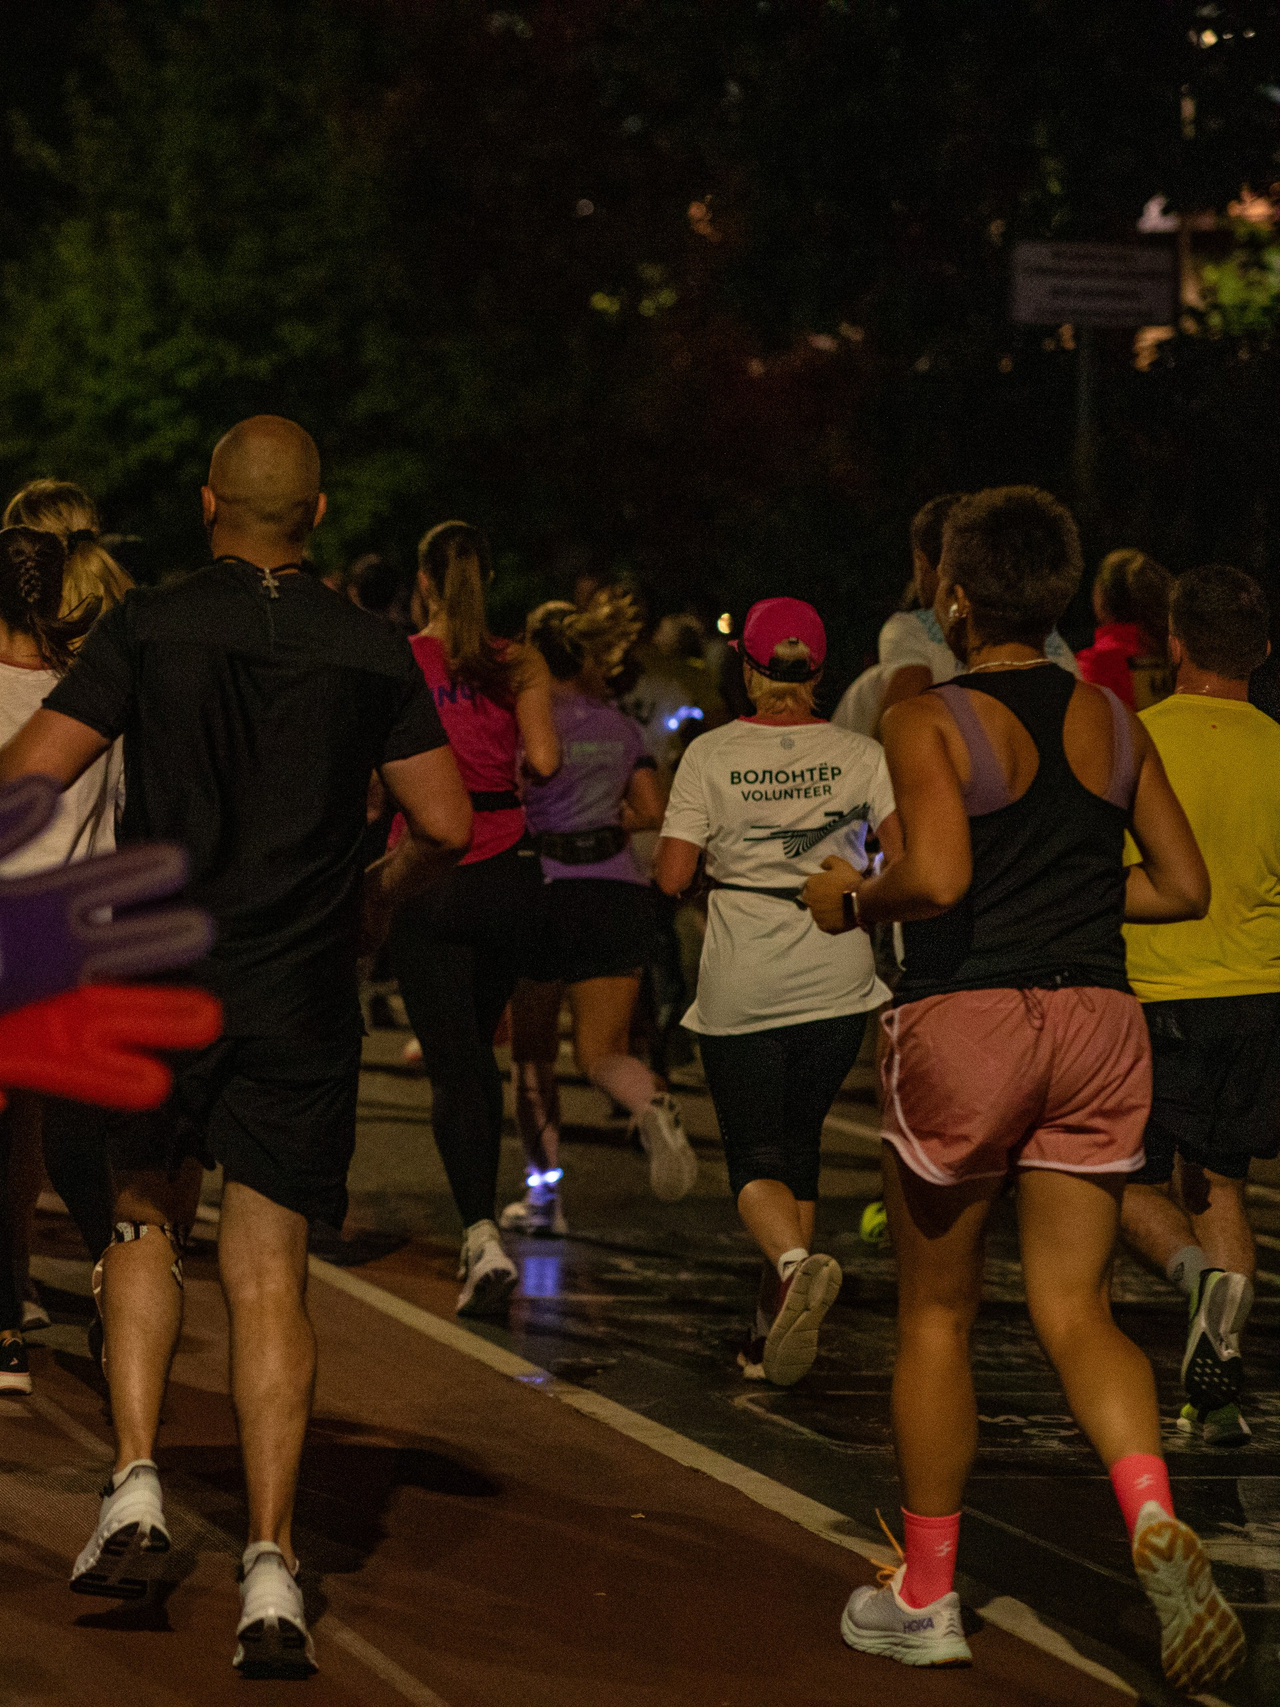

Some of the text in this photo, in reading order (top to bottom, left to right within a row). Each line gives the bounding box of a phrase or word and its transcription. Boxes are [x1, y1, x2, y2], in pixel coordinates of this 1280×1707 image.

[730, 763, 842, 785] ВОЛОНТЁР
[741, 785, 832, 801] VOLUNTEER
[903, 1617, 935, 1633] HOKA
